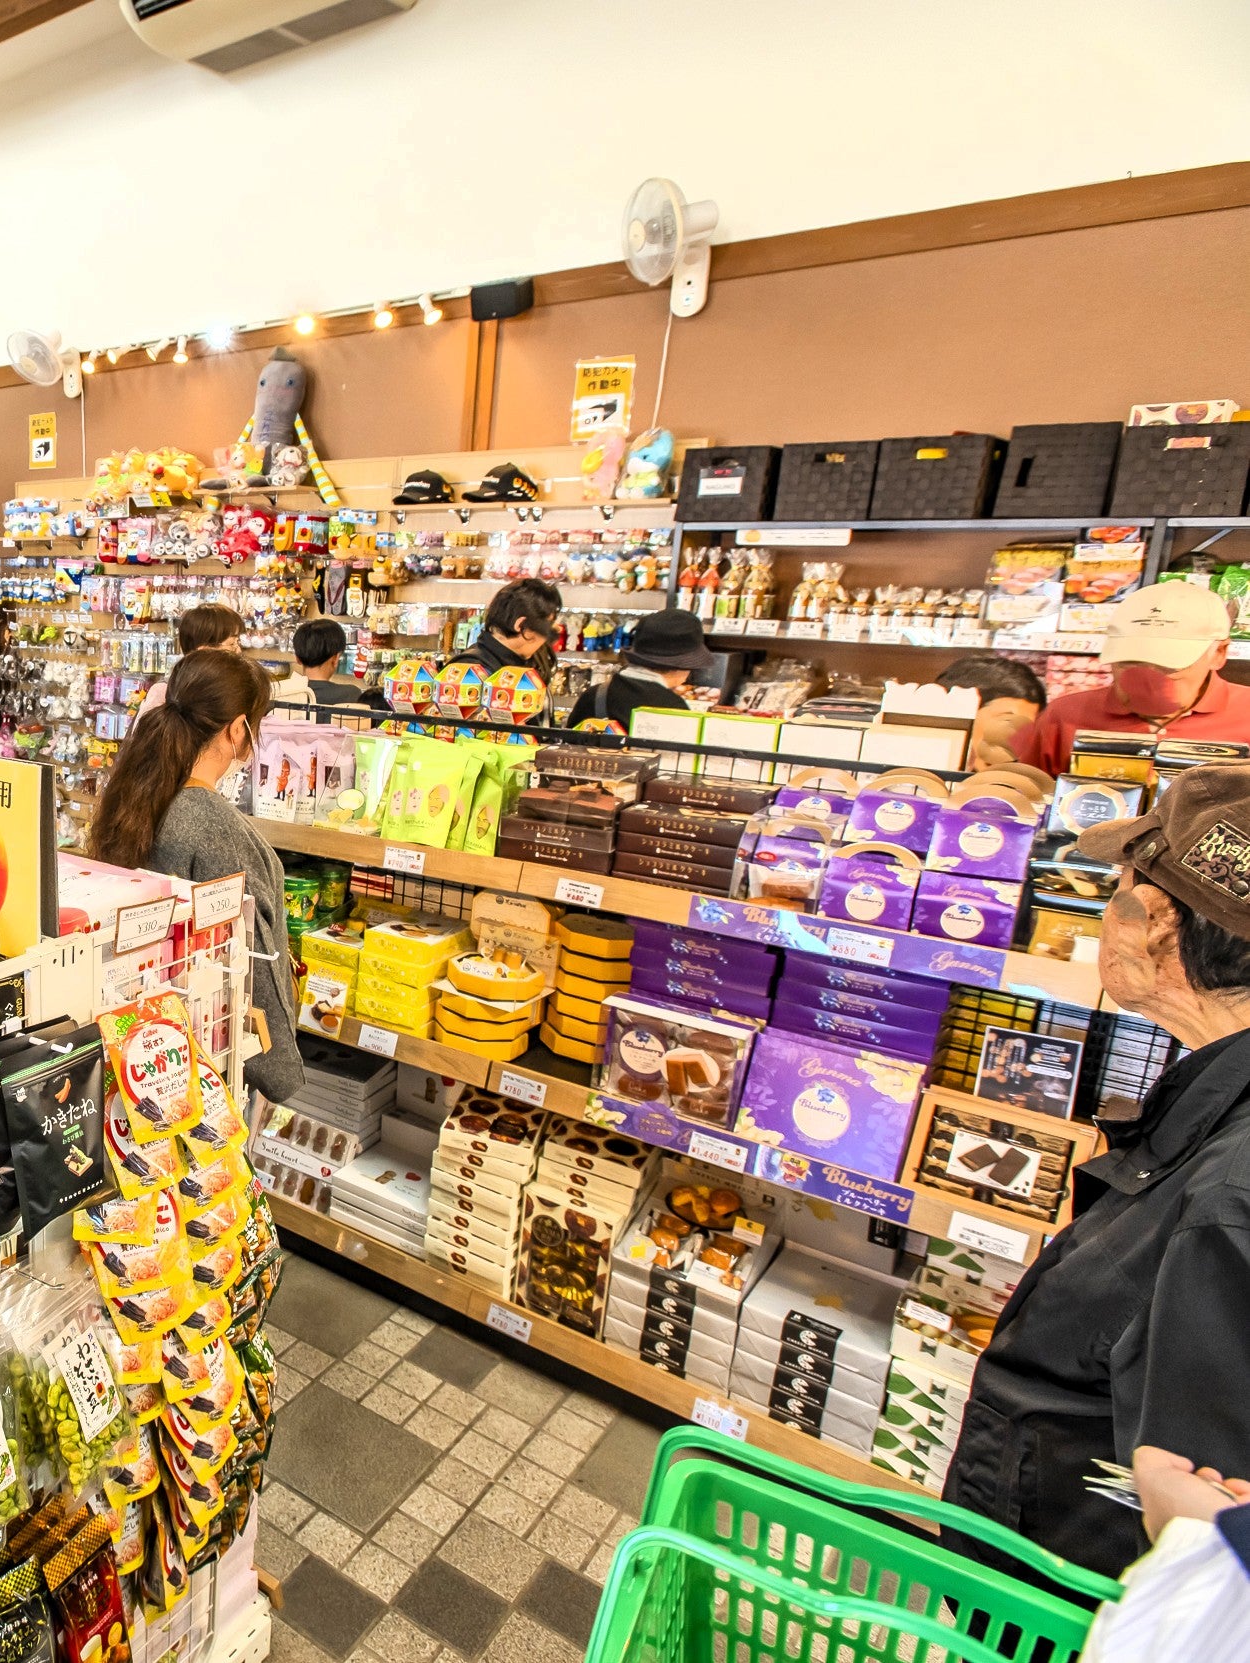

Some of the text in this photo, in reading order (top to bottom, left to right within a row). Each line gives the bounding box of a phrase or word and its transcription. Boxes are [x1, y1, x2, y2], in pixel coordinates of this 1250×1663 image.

[1199, 832, 1250, 872] Rusty
[138, 919, 158, 934] ¥310
[929, 950, 997, 978] Gunma
[130, 1044, 188, 1083] じゃがりこ
[798, 1057, 863, 1088] Gunma
[41, 1098, 98, 1136] かきたね
[799, 1098, 848, 1122] Blueberry
[822, 1166, 912, 1212] Blueberry
[836, 1198, 886, 1217] ミルクケーキ
